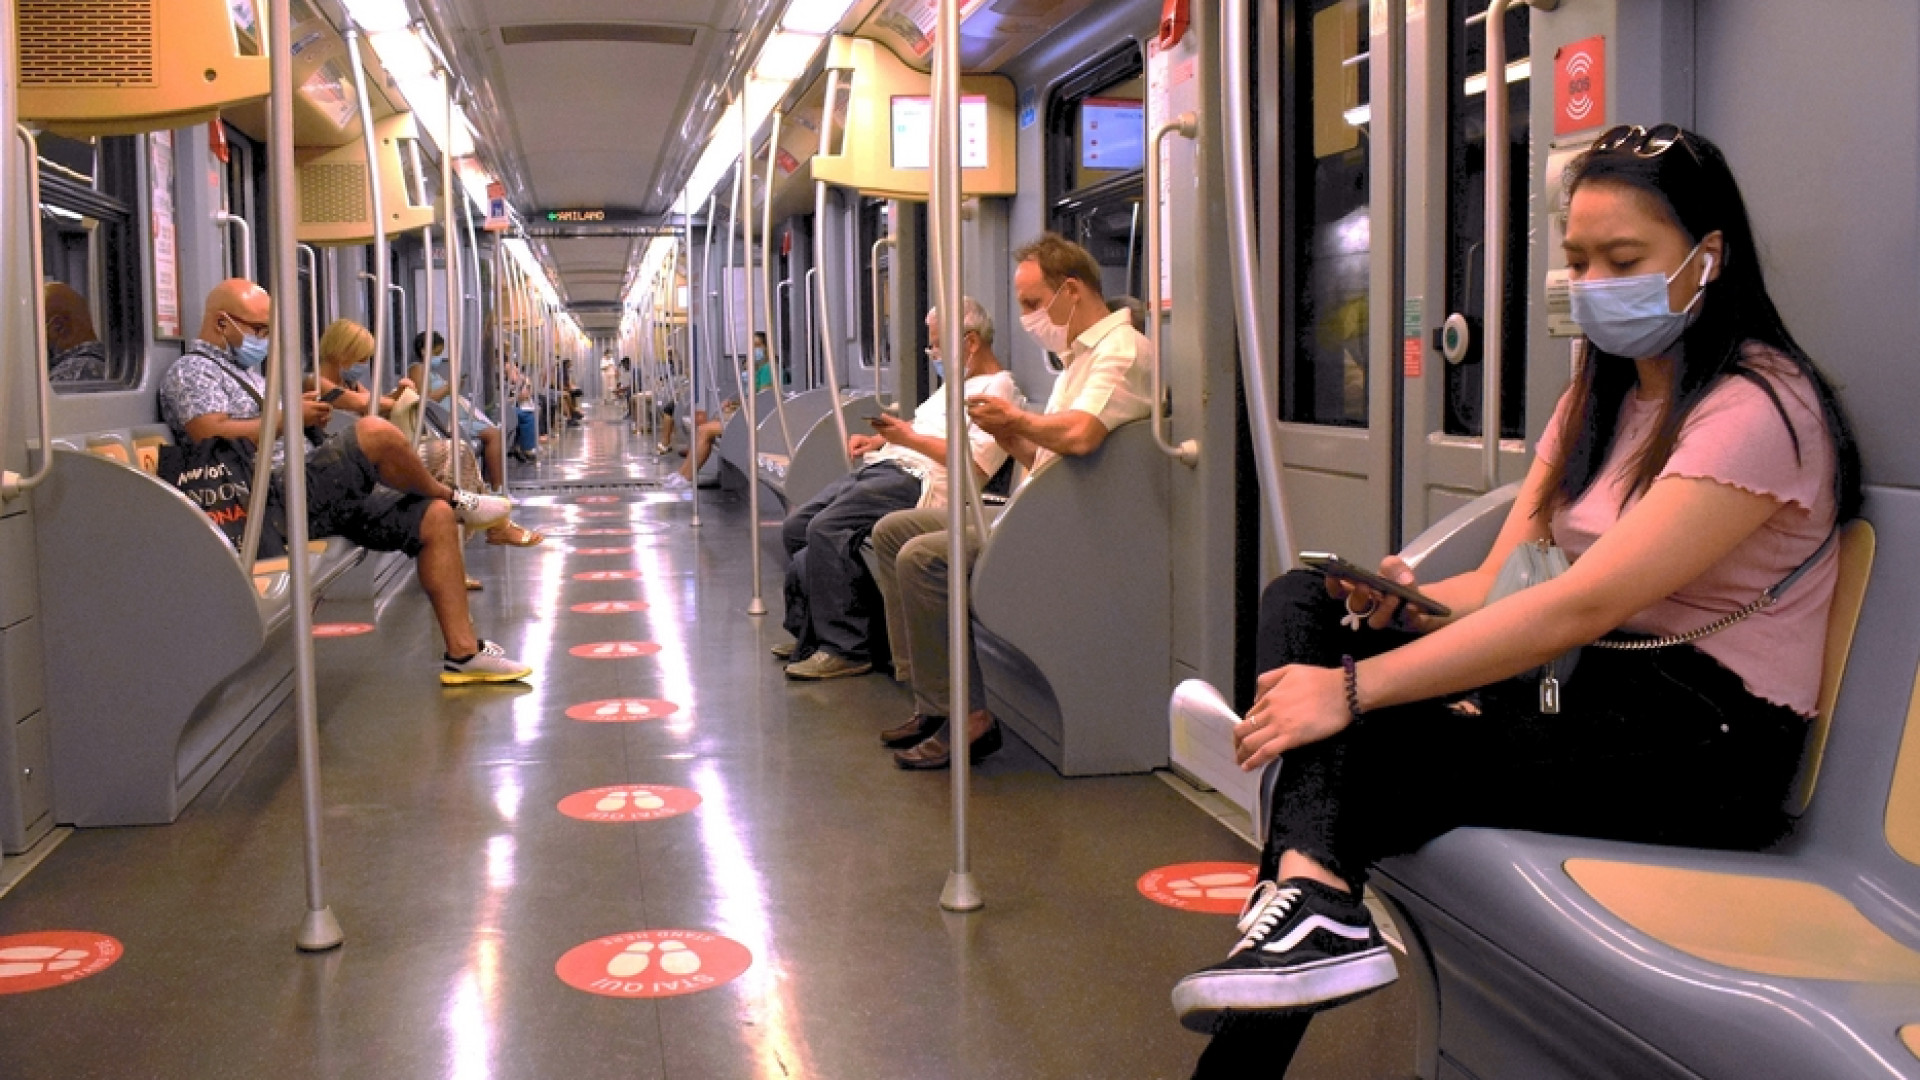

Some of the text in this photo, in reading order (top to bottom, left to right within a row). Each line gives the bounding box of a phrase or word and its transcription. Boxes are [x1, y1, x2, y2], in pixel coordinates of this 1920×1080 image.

[1569, 75, 1591, 95] SOS
[590, 974, 715, 993] STAI QUI
